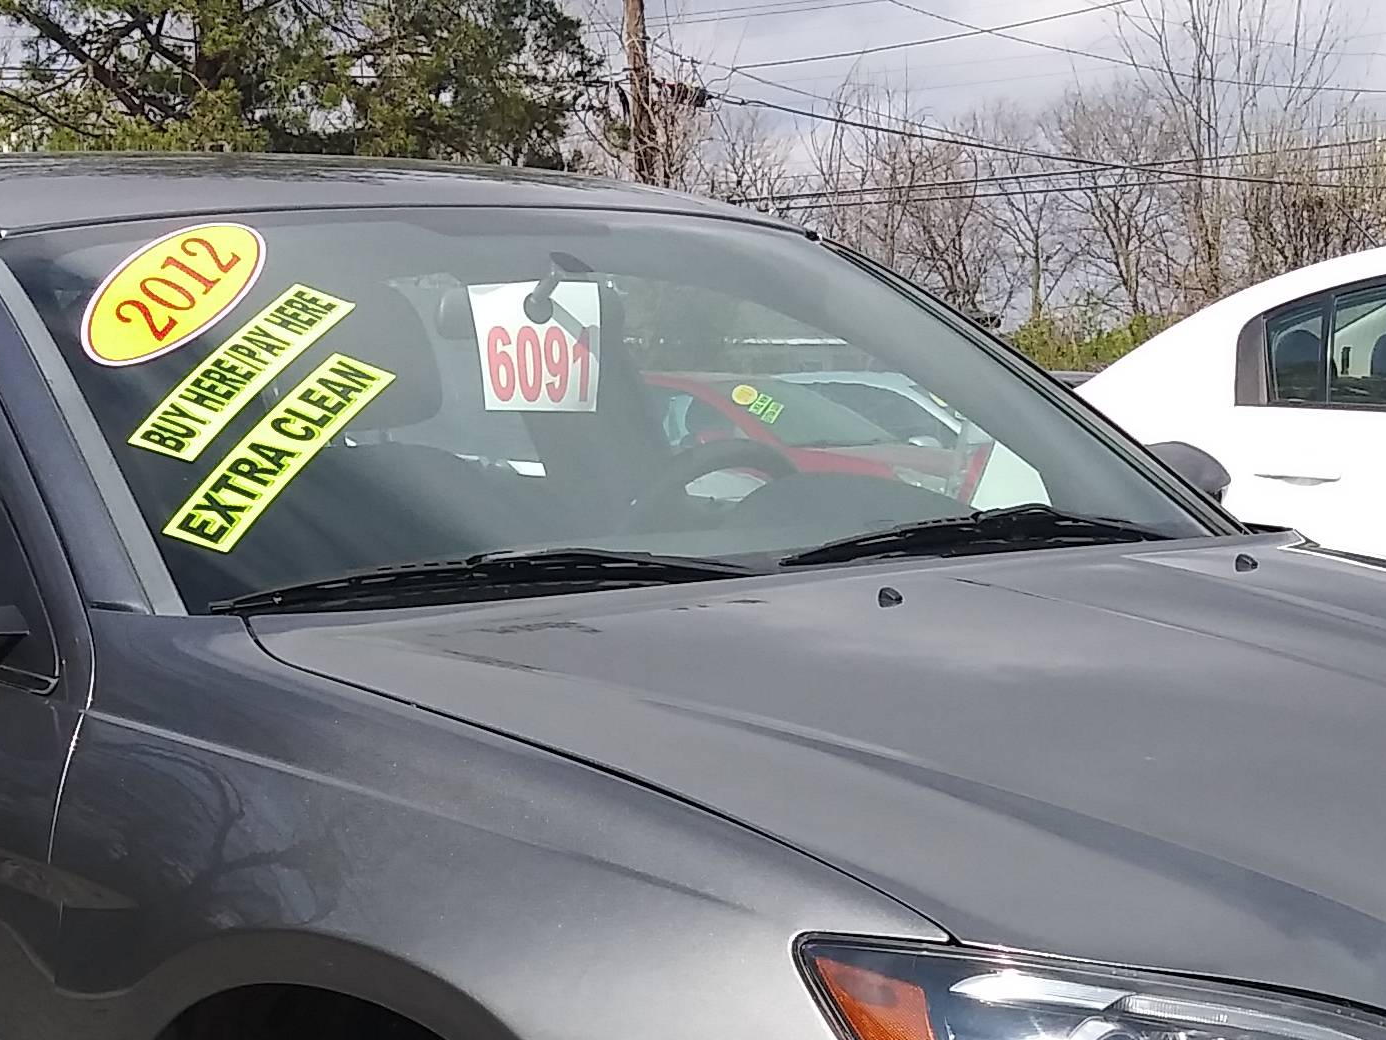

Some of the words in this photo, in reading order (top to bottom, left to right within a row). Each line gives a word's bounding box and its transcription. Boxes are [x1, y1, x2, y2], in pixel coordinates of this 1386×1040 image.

[115, 238, 241, 341] 2012
[140, 403, 211, 453] BUY
[178, 325, 291, 412] HERE/PAY
[263, 290, 337, 336] HERE
[487, 325, 591, 404] 6091
[176, 442, 302, 545] EXTRA
[271, 360, 380, 442] CLEAN
